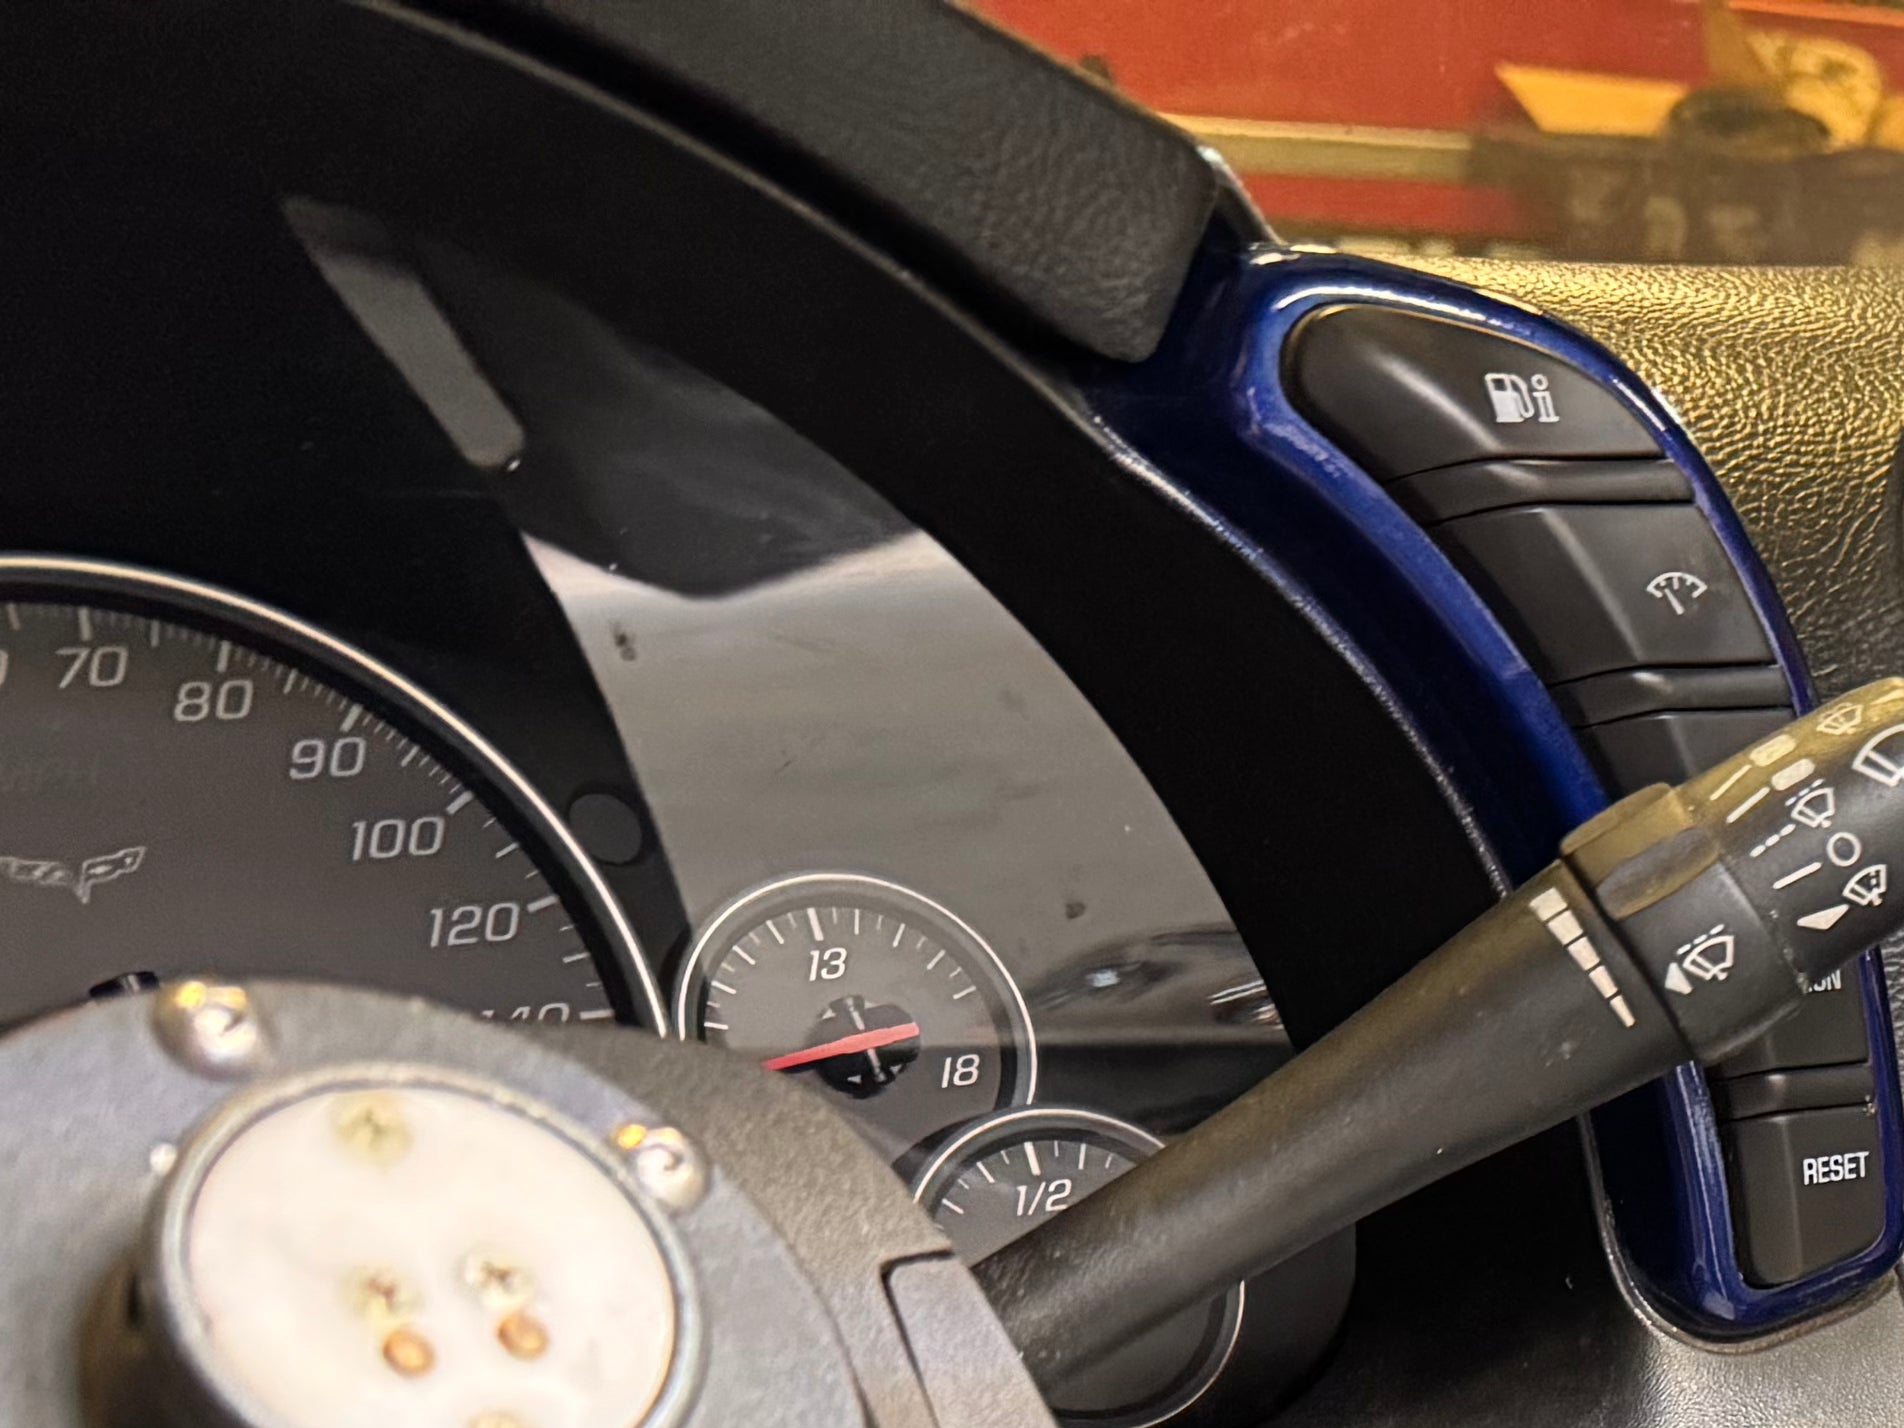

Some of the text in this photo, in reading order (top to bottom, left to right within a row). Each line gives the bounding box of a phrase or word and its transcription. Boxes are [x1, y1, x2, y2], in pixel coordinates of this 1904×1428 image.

[55, 646, 129, 689] 70
[173, 679, 254, 722] 80
[289, 736, 367, 780] 90
[352, 816, 446, 861] 100
[429, 902, 520, 948] 120
[808, 947, 848, 982] 13
[941, 1053, 981, 1089] 18
[1802, 1150, 1870, 1186] RESET
[1016, 1178, 1073, 1217] 1/2
